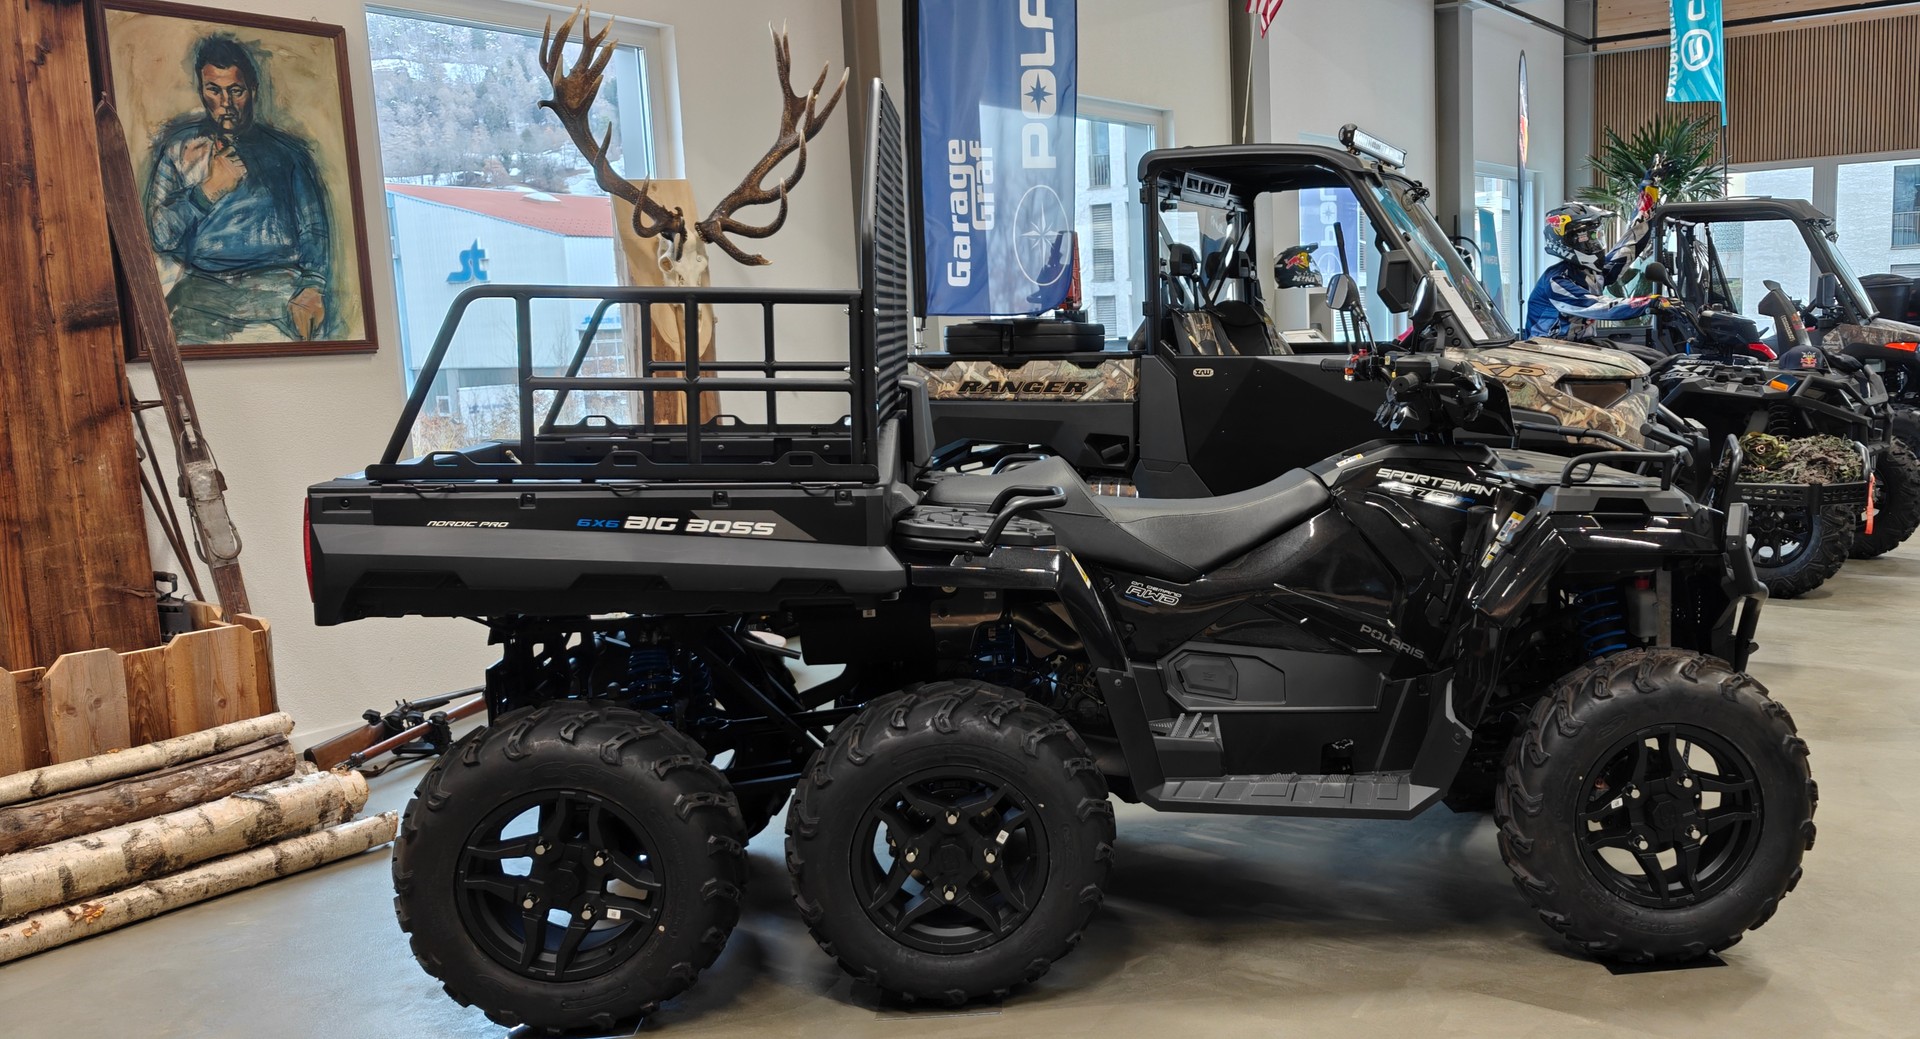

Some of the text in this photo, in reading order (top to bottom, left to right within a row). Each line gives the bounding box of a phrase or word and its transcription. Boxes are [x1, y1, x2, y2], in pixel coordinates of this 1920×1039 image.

[969, 140, 995, 231] Graf
[947, 139, 974, 287] Garage
[1469, 361, 1546, 378] XP
[957, 381, 1089, 396] RANGER
[1376, 467, 1495, 497] SPORTSMAN
[623, 515, 679, 531] BIG
[685, 518, 777, 536] BOSS
[1125, 585, 1179, 606] AWD
[1146, 585, 1182, 598] DEMAND
[1360, 623, 1425, 659] POLARIS
